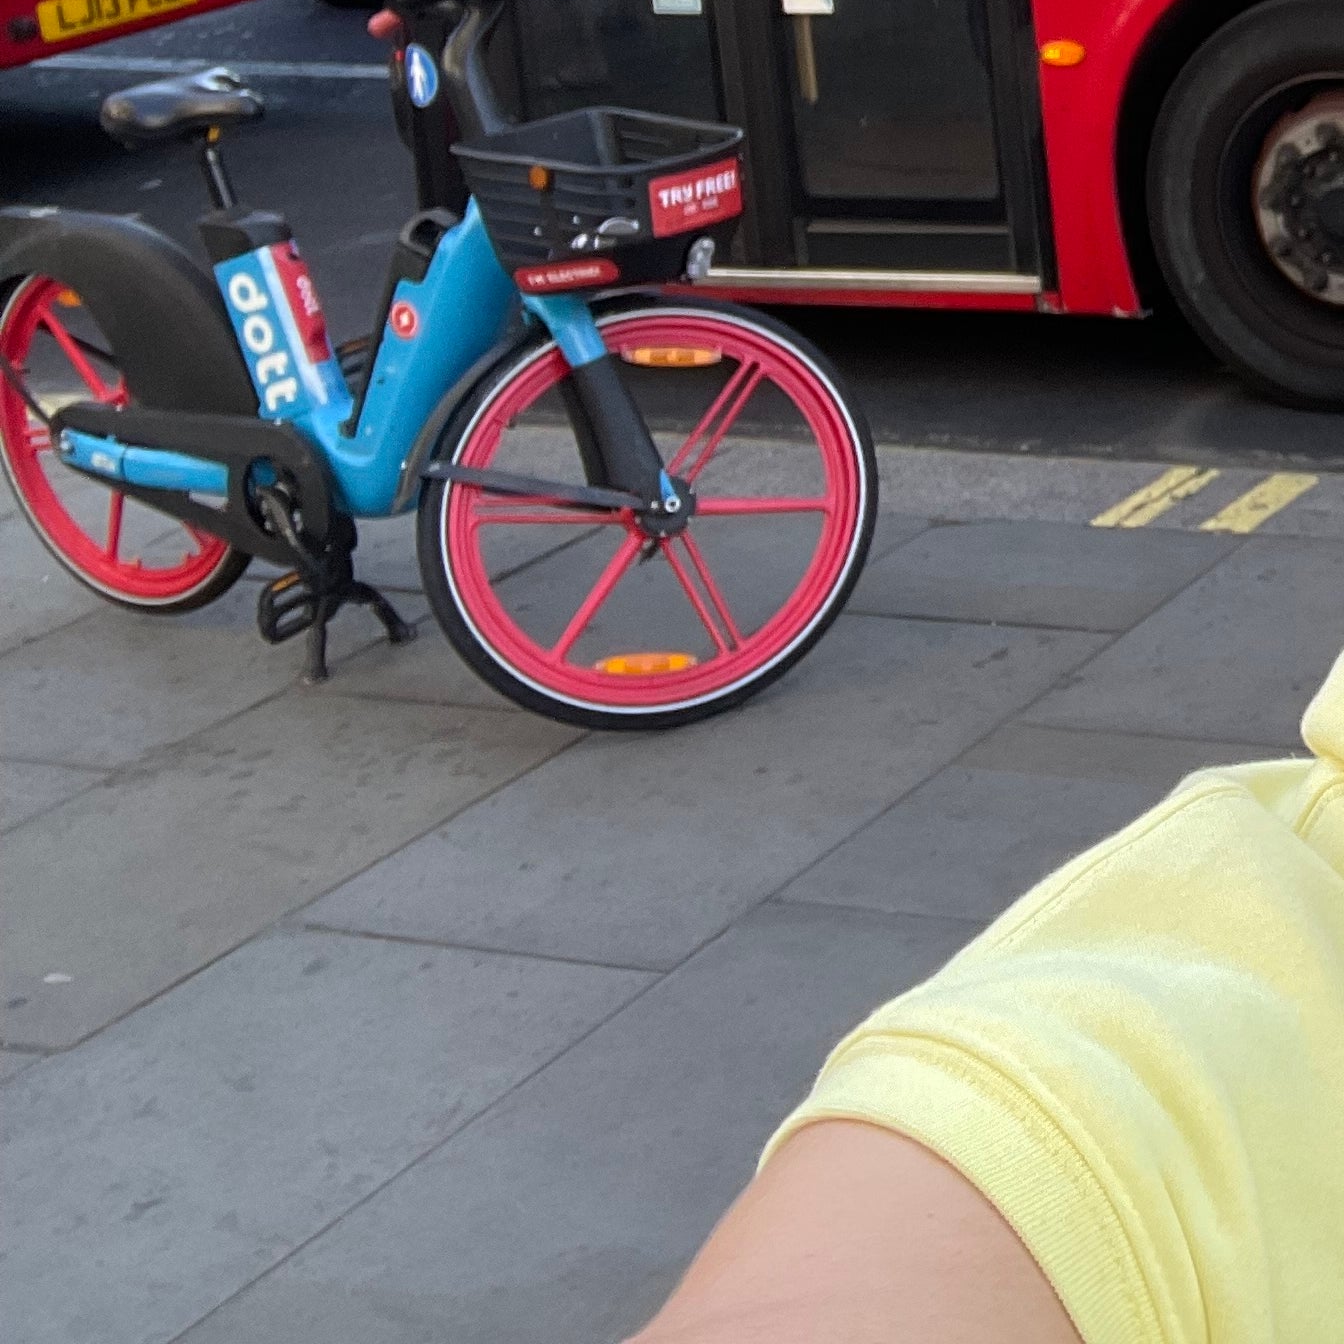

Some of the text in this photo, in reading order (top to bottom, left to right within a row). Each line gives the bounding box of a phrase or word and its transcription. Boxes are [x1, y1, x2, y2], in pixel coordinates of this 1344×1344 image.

[658, 169, 736, 209] TRY FREE!
[228, 271, 298, 413] dott
